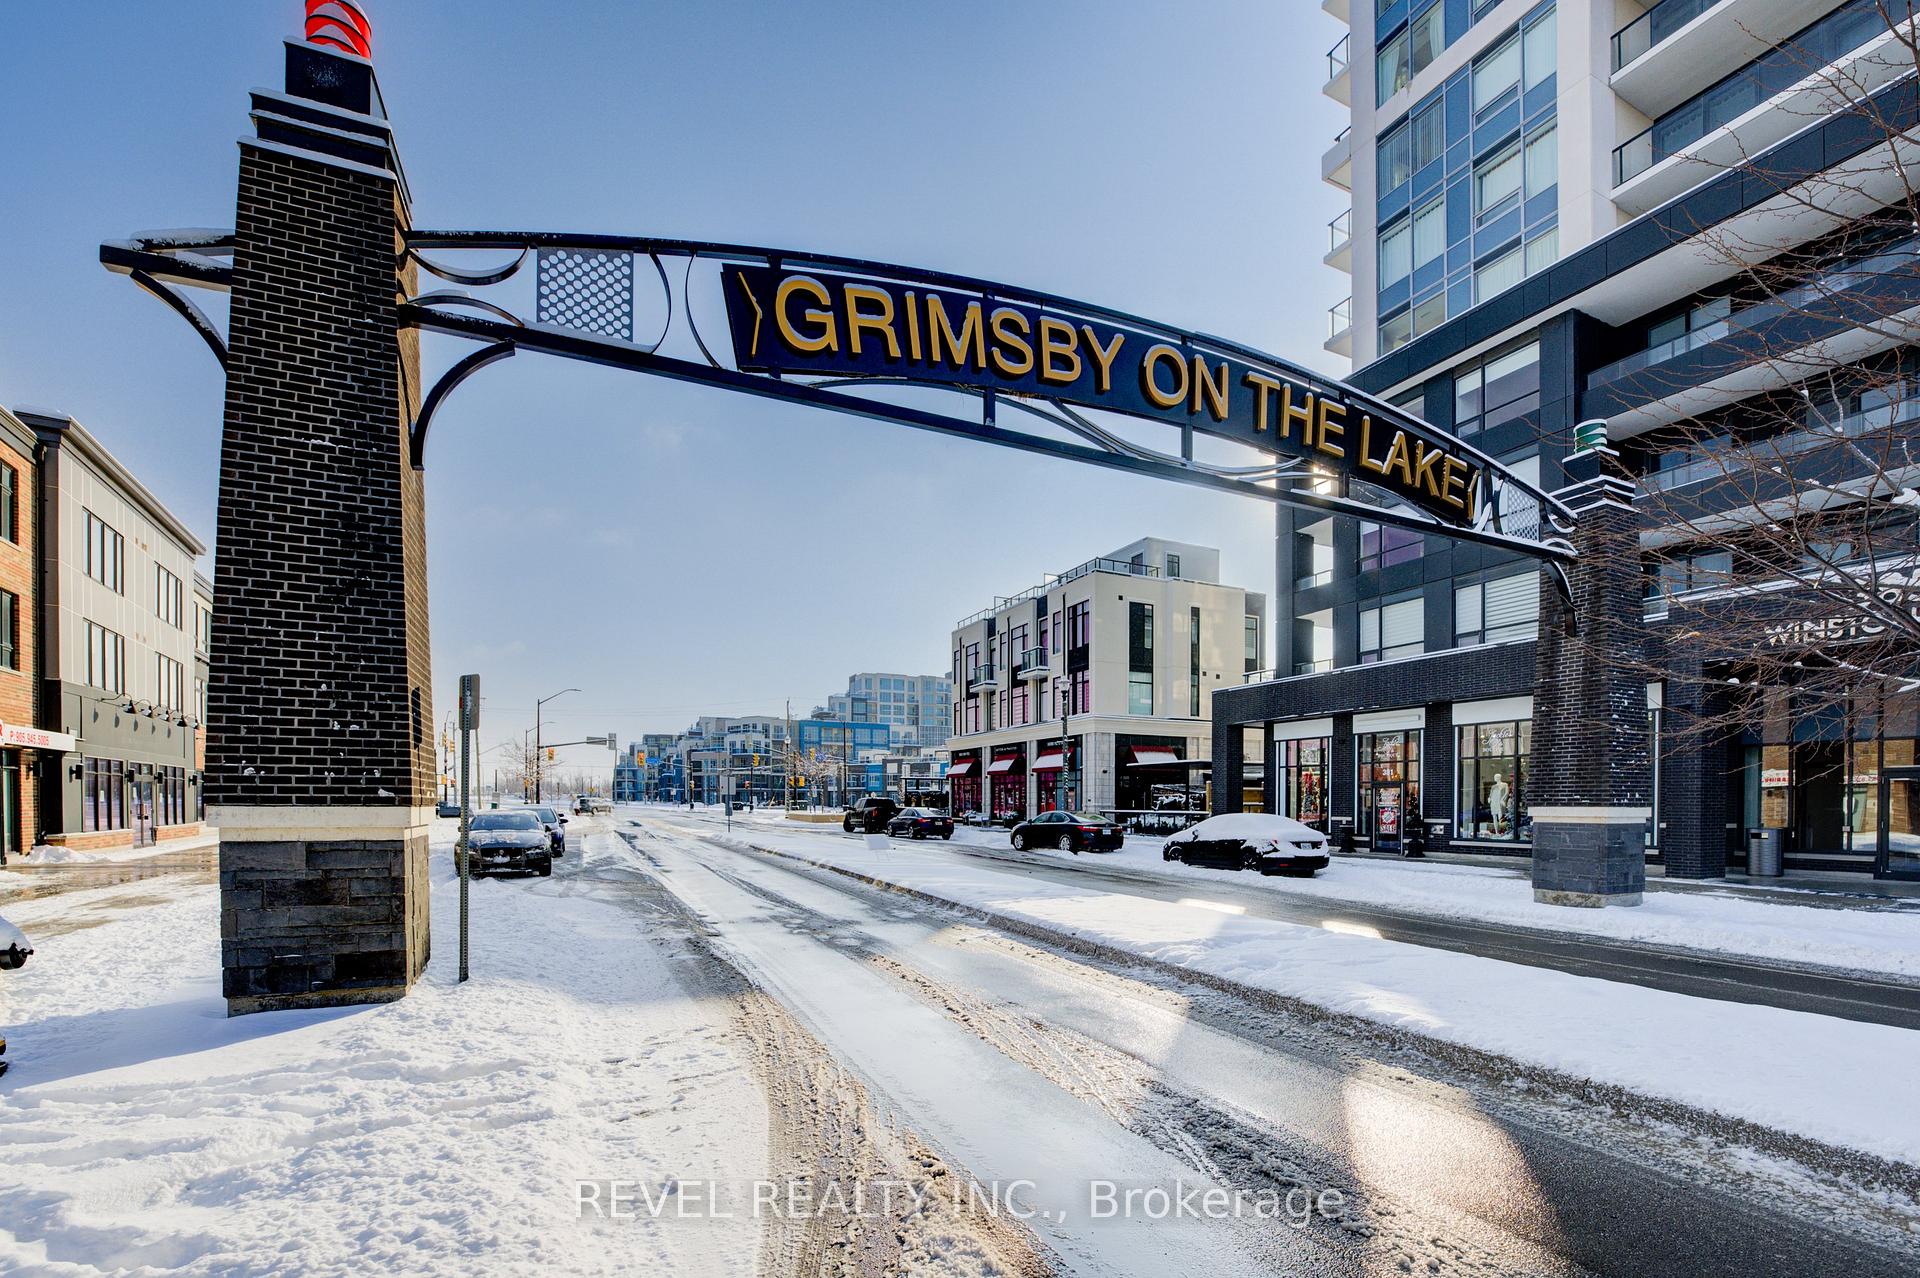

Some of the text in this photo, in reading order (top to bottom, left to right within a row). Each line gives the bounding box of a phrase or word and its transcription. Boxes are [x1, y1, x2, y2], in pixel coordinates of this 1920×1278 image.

[775, 274, 1468, 509] GRIMSBY ON THE LAKE
